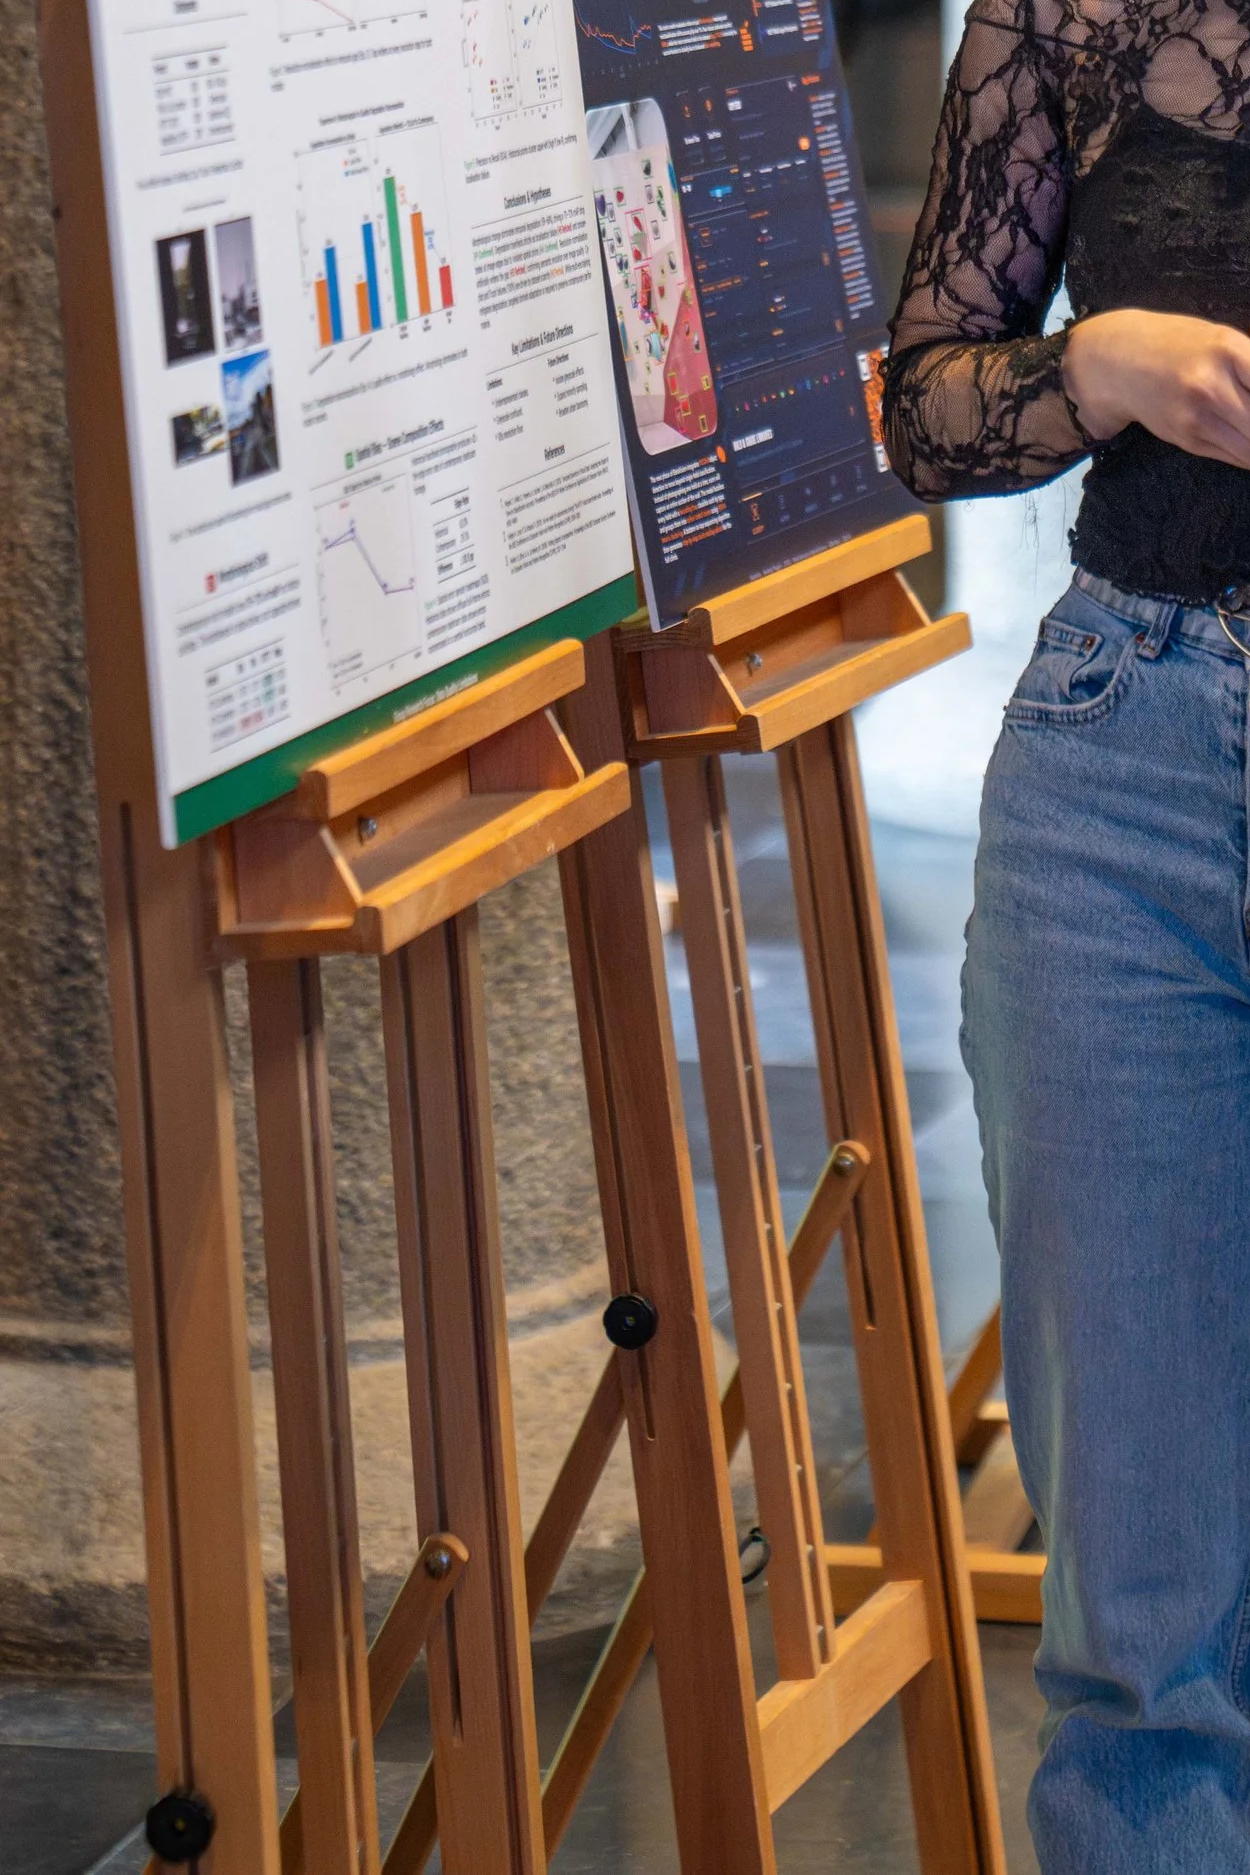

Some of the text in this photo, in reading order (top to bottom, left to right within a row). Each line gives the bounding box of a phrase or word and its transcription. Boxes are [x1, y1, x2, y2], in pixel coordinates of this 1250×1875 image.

[504, 192, 527, 209] Conclusions
[530, 187, 551, 205] Hypotheses
[511, 341, 519, 357] Key
[519, 335, 540, 353] Limitations
[543, 331, 555, 343] Future
[555, 324, 574, 340] Directions
[544, 444, 565, 461] References
